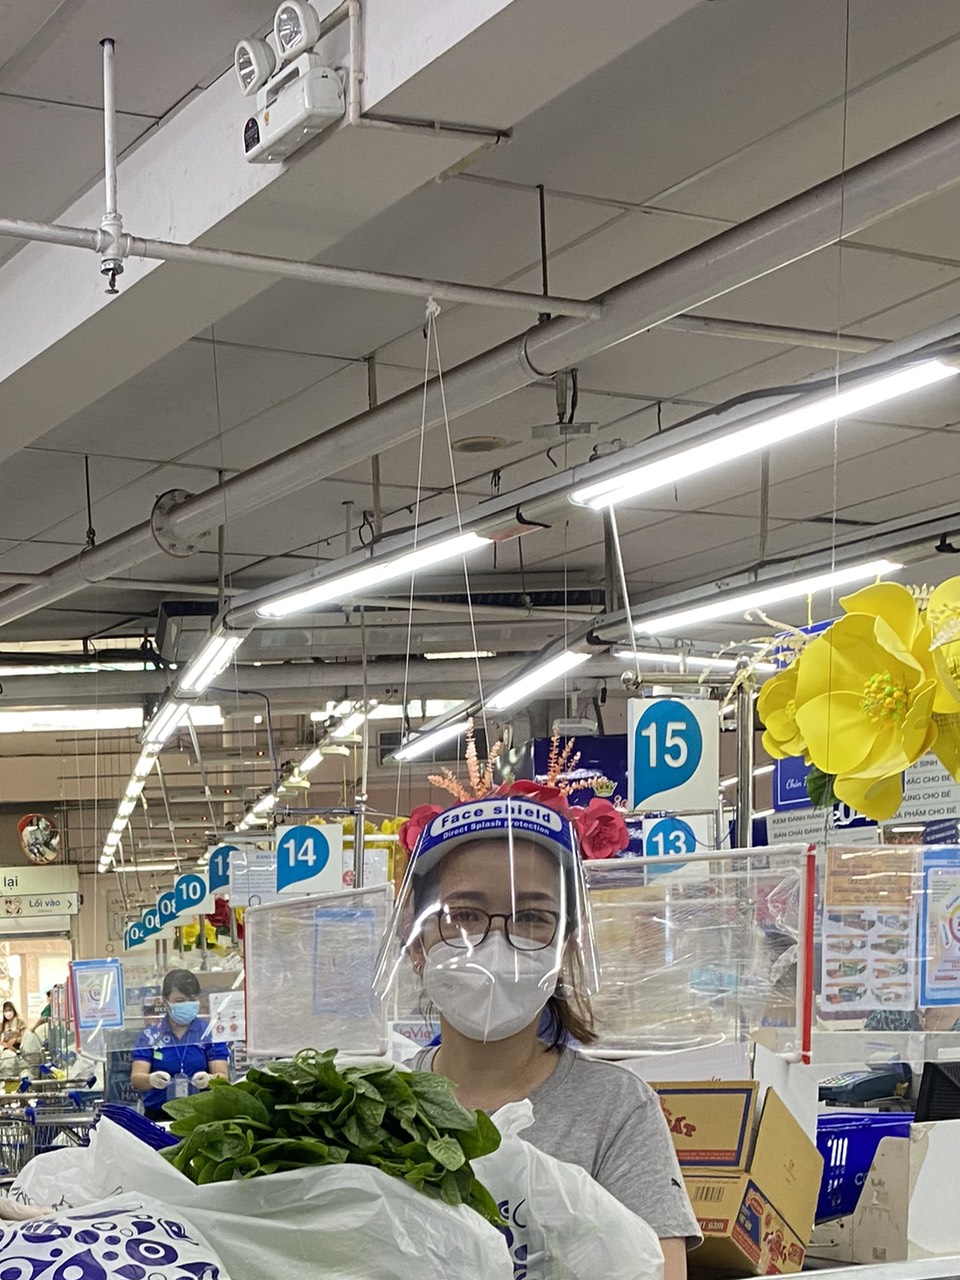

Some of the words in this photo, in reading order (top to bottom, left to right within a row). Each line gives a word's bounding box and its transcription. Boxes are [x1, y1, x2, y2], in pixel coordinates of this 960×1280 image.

[641, 721, 689, 769] 15
[922, 775, 940, 784] CHO
[922, 792, 940, 800] CHO
[441, 807, 484, 828] Face
[493, 804, 552, 824] shield
[928, 807, 945, 816] CHO
[442, 826, 469, 840] Direct
[470, 819, 502, 831] Splash
[282, 837, 318, 868] 14
[651, 830, 688, 857] 13
[214, 855, 230, 877] 1
[3, 876, 18, 891] lại
[178, 881, 202, 901] 10
[29, 900, 43, 908] Lối
[45, 899, 61, 907] vào
